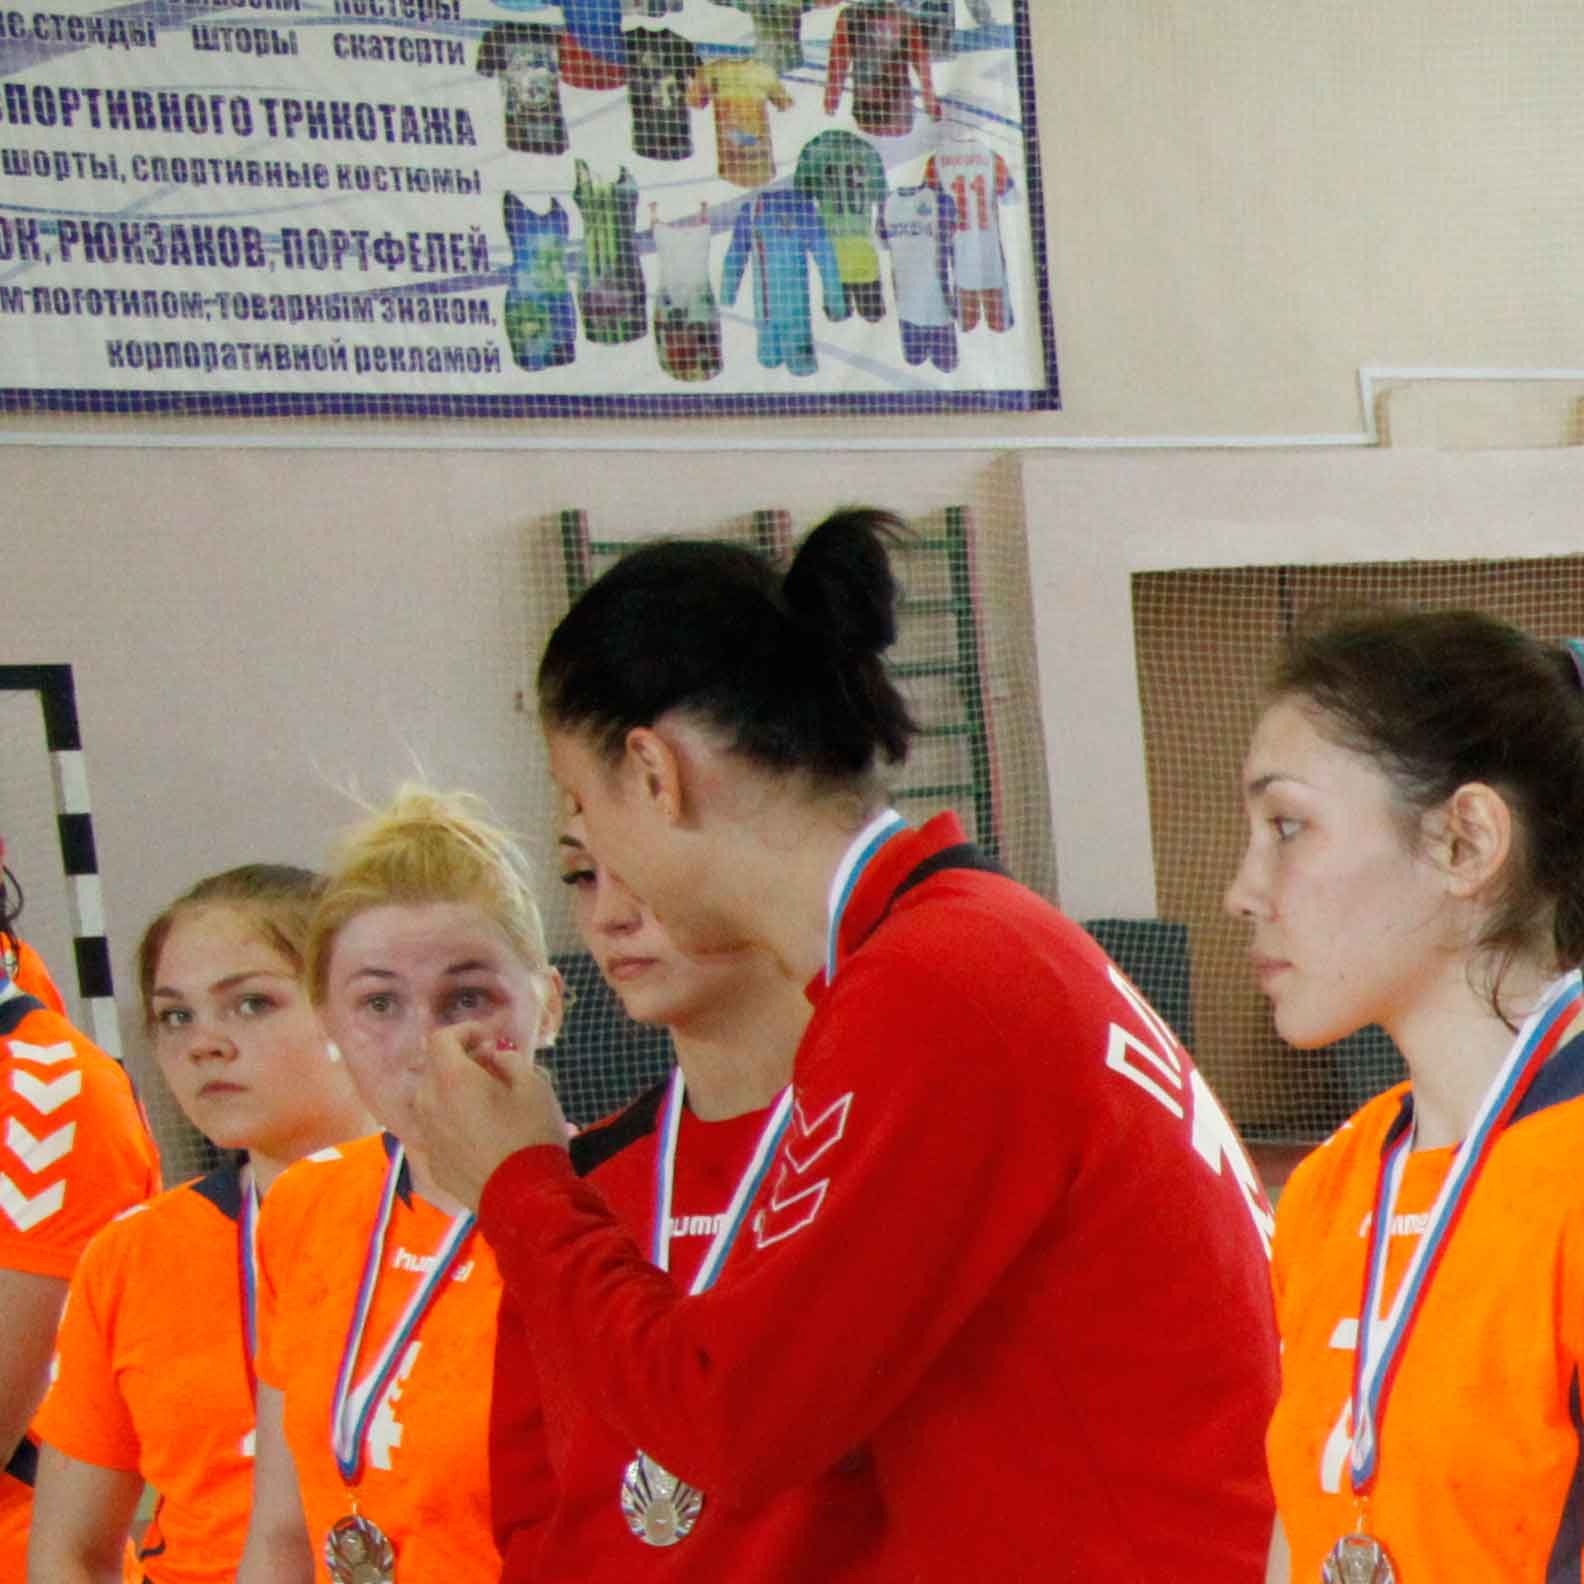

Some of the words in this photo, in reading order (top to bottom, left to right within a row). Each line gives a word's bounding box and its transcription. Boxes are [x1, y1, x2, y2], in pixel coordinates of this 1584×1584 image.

[191, 24, 299, 57] шторы
[333, 32, 466, 66] скатерти
[0, 83, 254, 136] ПОРТИВНОГО
[260, 98, 478, 146] ТРИКОТАЖА
[132, 154, 330, 189] спортивные
[336, 163, 481, 194] костюмы
[57, 219, 275, 272] РЮКЗАКОВ,
[281, 225, 491, 273] ПОРТФЕЛЕЙ
[215, 291, 375, 325] товарным
[380, 296, 498, 327] знаком,
[105, 338, 349, 373] корпоративной
[353, 339, 502, 375] рекламой
